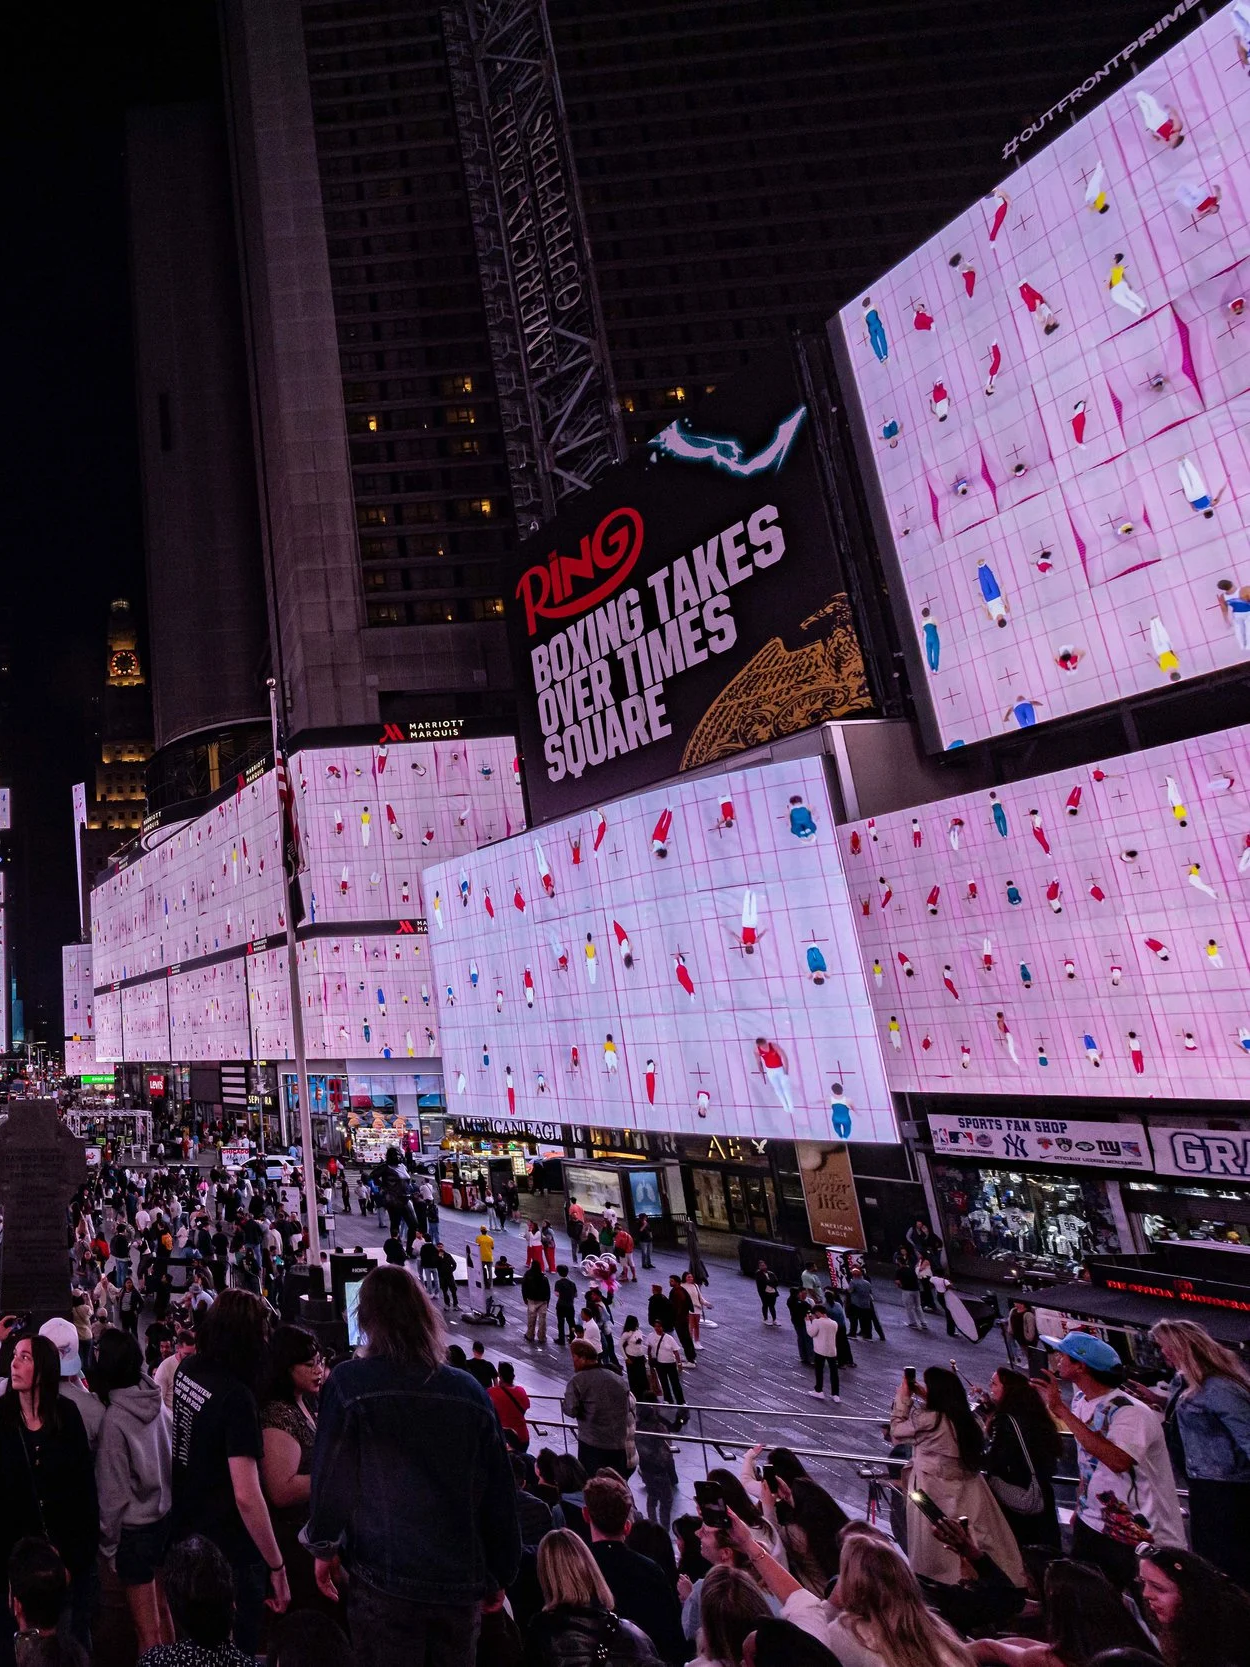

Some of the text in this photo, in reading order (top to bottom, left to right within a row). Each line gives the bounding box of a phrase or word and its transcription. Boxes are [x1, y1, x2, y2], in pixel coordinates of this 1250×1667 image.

[530, 504, 786, 694] BOXING TAKES
[537, 593, 738, 737] OVER TIMES
[409, 719, 464, 730] MARRIOTT
[544, 683, 672, 783] SQUARE
[410, 728, 459, 739] MARQUIS
[245, 757, 266, 776] MARRIOTT
[246, 767, 264, 784] MARQUIS
[248, 1095, 272, 1106] SEPRA
[525, 1121, 564, 1142] EAGL
[957, 1117, 1068, 1134] SPORTS FAN SHOP
[708, 1135, 743, 1161] AE
[1170, 1132, 1250, 1176] GR
[817, 1193, 849, 1211] life
[820, 1222, 853, 1232] AMERICAN
[827, 1229, 847, 1238] EAGLE
[1064, 1222, 1077, 1231] 99
